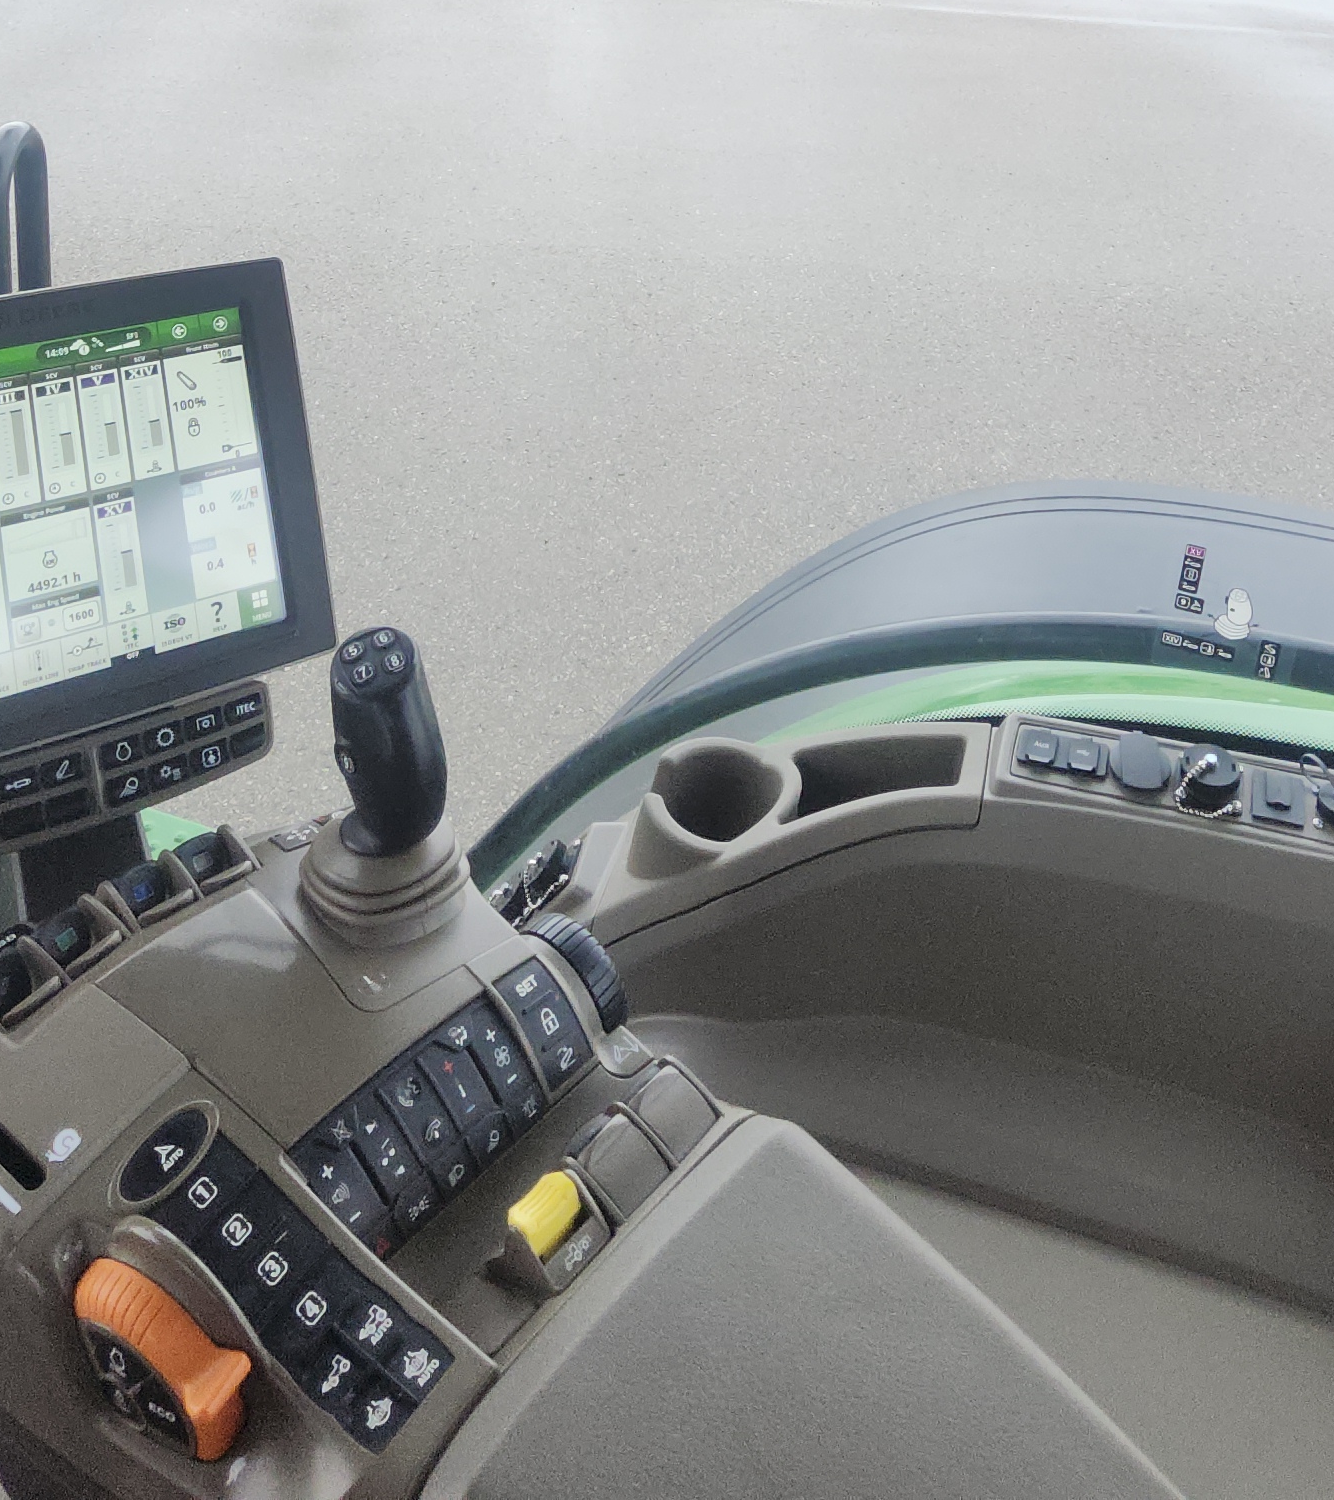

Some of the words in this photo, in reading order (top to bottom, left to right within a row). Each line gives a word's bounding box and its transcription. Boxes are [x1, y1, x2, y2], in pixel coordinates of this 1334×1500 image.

[217, 349, 232, 359] 100
[128, 365, 154, 380] XIV
[93, 375, 103, 386] V
[45, 383, 62, 396] IV
[0, 393, 16, 405] III
[172, 397, 207, 412] 100%
[104, 502, 125, 518] XV
[199, 502, 216, 514] 0.0
[207, 558, 224, 571] 0.4
[27, 575, 69, 594] 4492.1
[73, 571, 81, 583] h
[68, 608, 94, 622] 1600
[163, 616, 186, 631] ISO
[390, 654, 400, 667] 8
[515, 974, 538, 998] SET
[162, 1147, 184, 1172] AUTO
[195, 1185, 211, 1200] 1
[229, 1220, 247, 1241] 2
[264, 1259, 281, 1278] 3
[304, 1299, 320, 1318] 4
